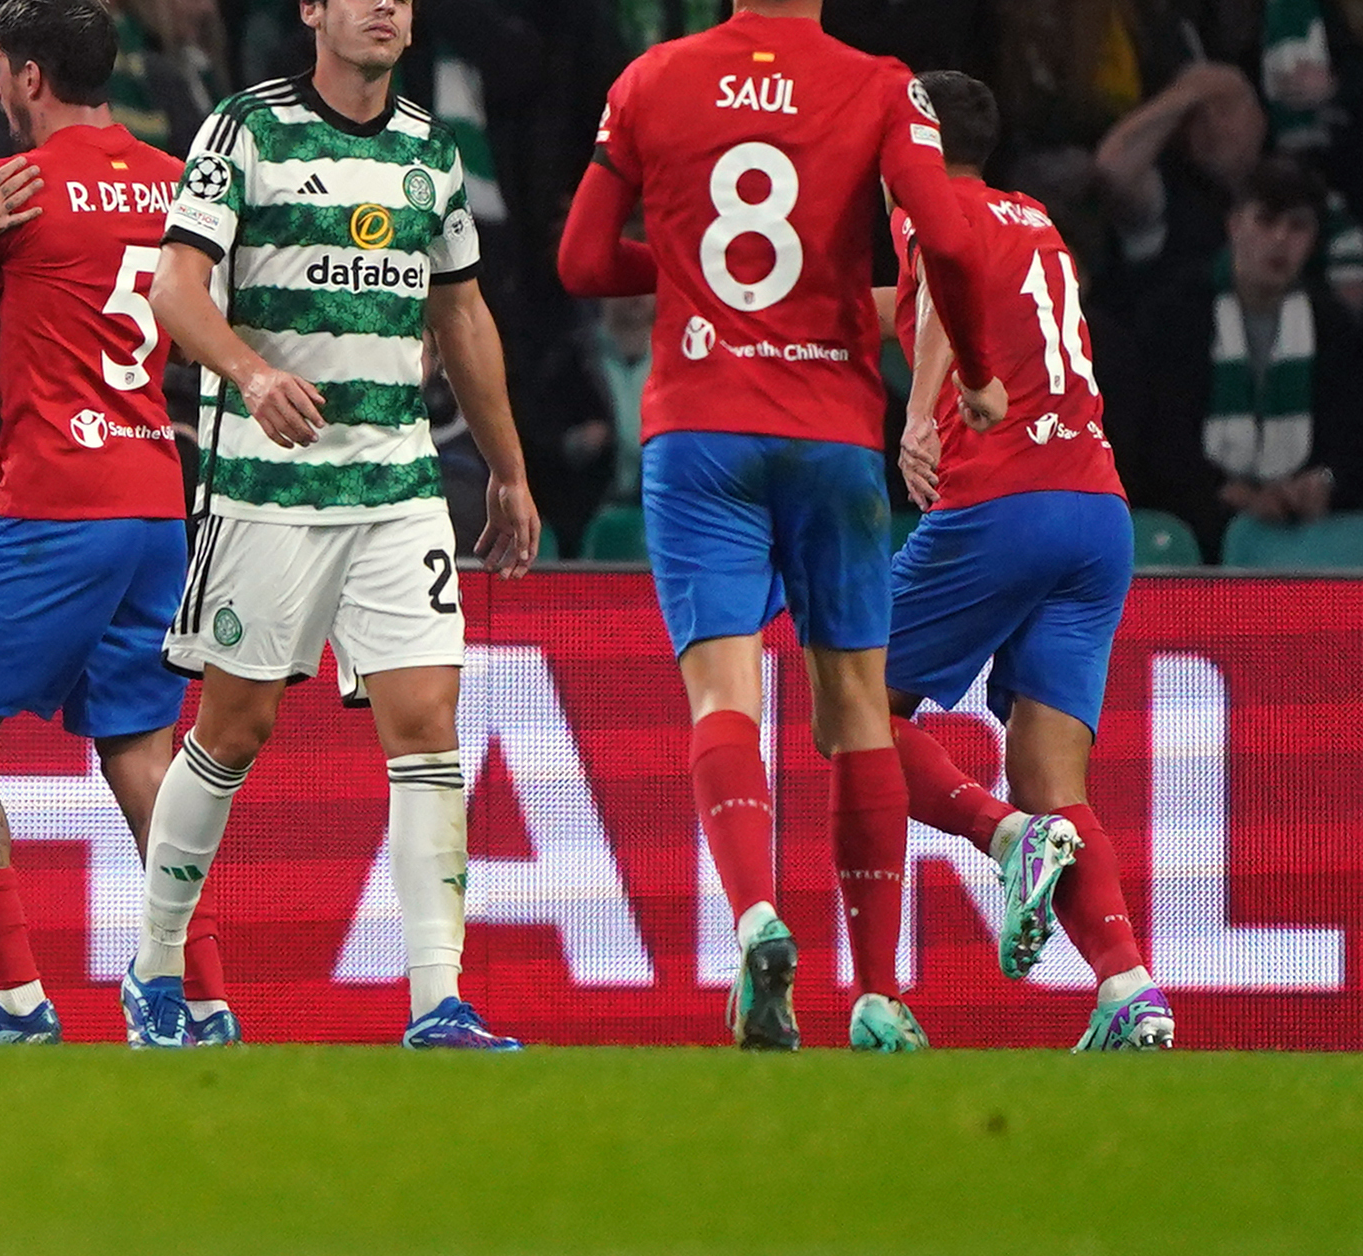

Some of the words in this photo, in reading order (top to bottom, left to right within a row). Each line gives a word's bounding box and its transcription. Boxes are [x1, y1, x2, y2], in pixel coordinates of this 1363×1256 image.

[716, 73, 798, 114] SAÚL
[66, 181, 96, 212] R.
[97, 181, 131, 212] DE
[132, 181, 180, 214] PAU
[700, 141, 803, 312] 8
[306, 256, 425, 292] dafabet
[101, 245, 164, 391] 5
[135, 425, 161, 440] the
